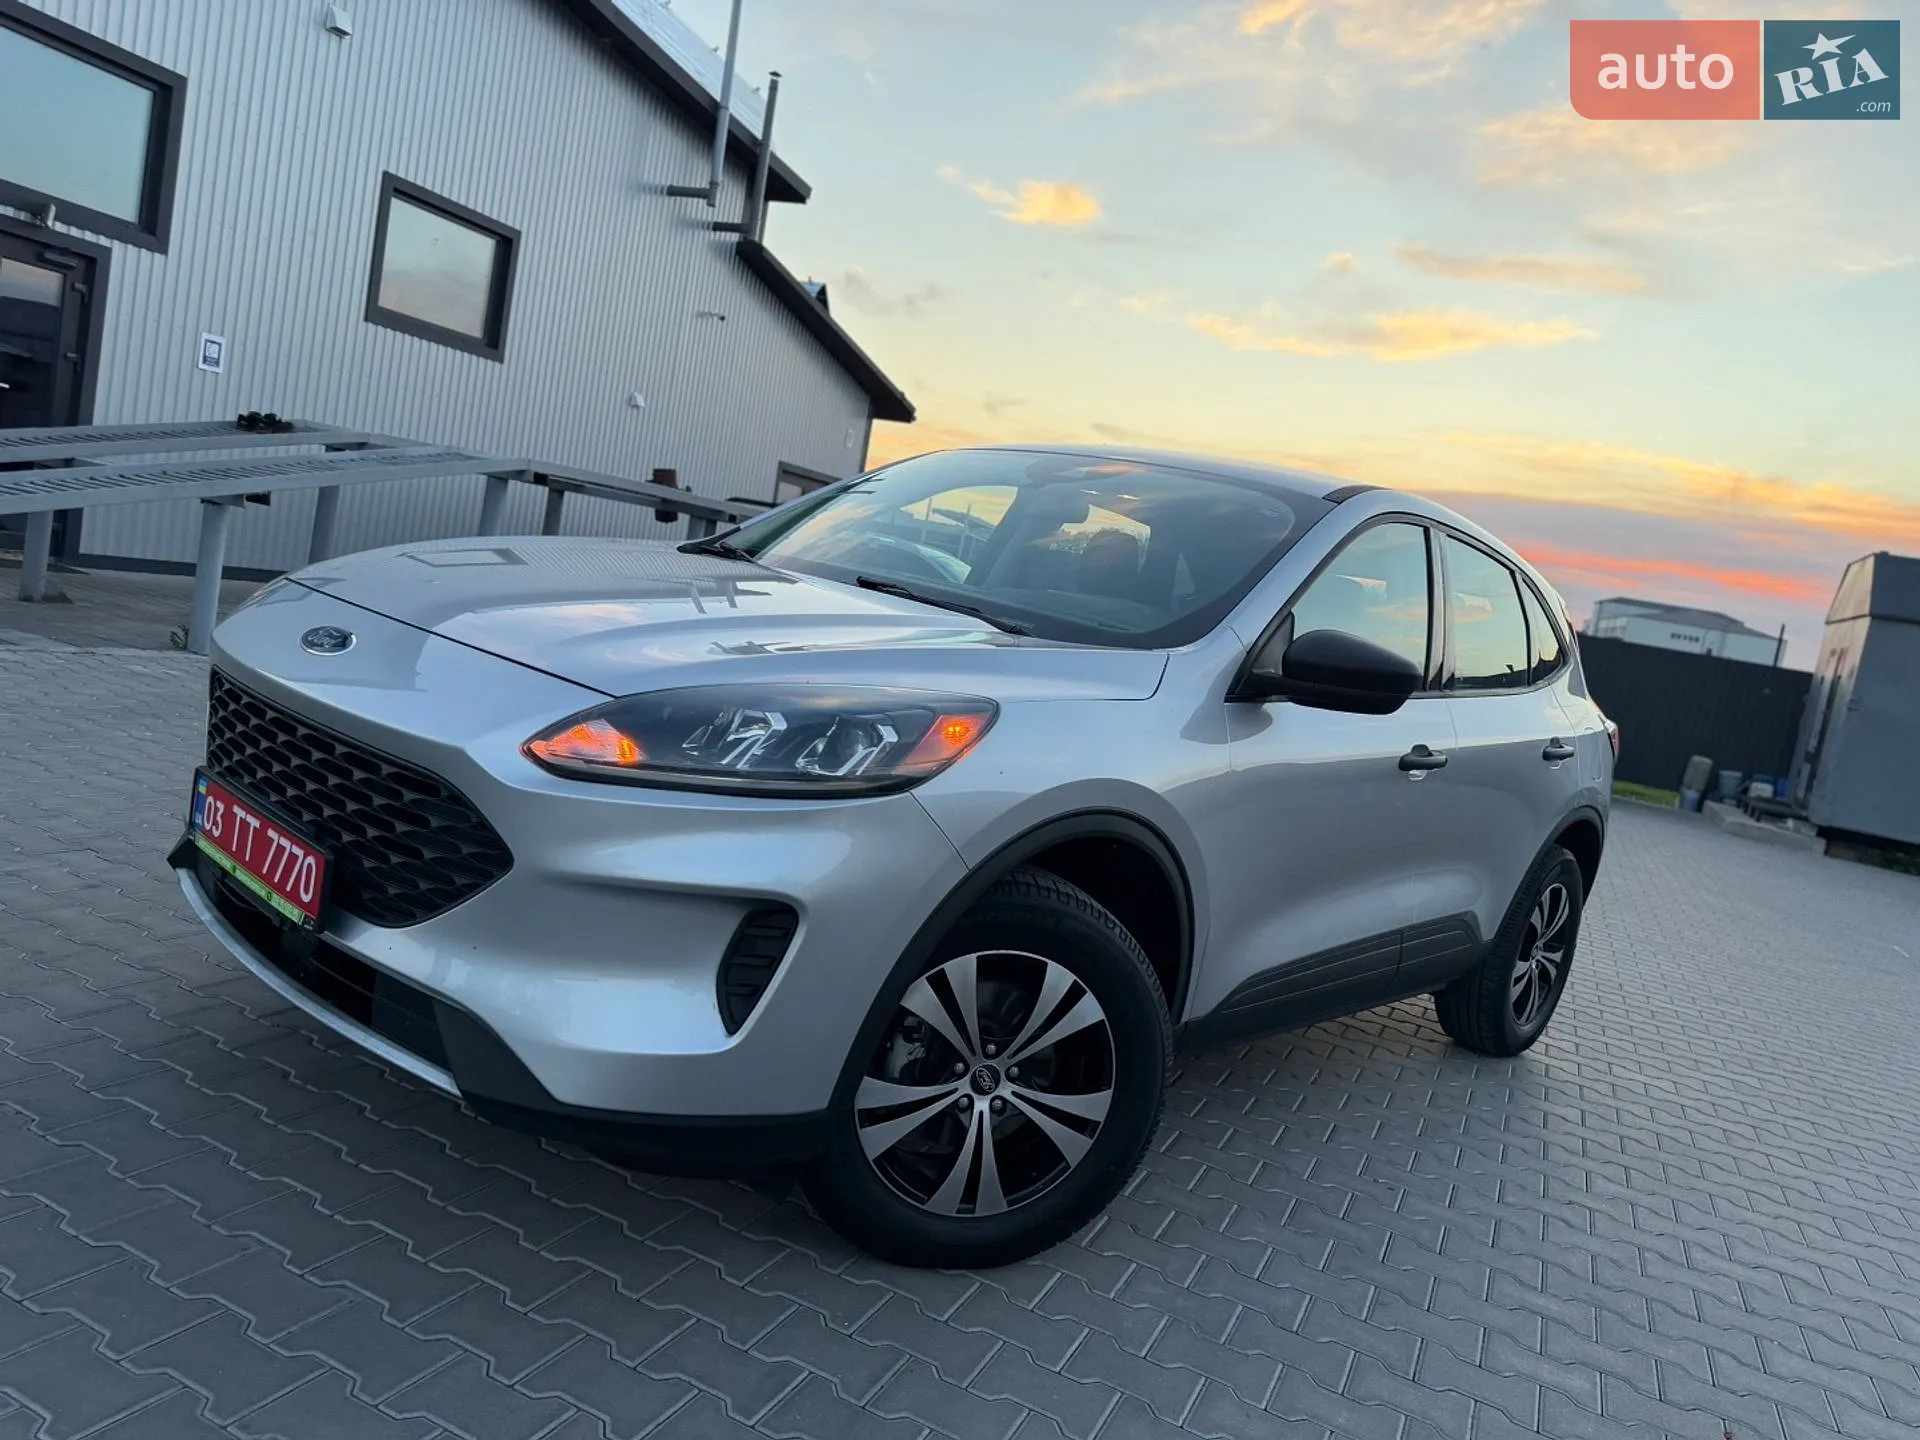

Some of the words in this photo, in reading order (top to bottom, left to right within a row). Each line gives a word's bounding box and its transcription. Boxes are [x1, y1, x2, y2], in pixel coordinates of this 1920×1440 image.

[203, 796, 225, 837] 03
[232, 804, 261, 862] TT
[262, 828, 316, 903] 7770
